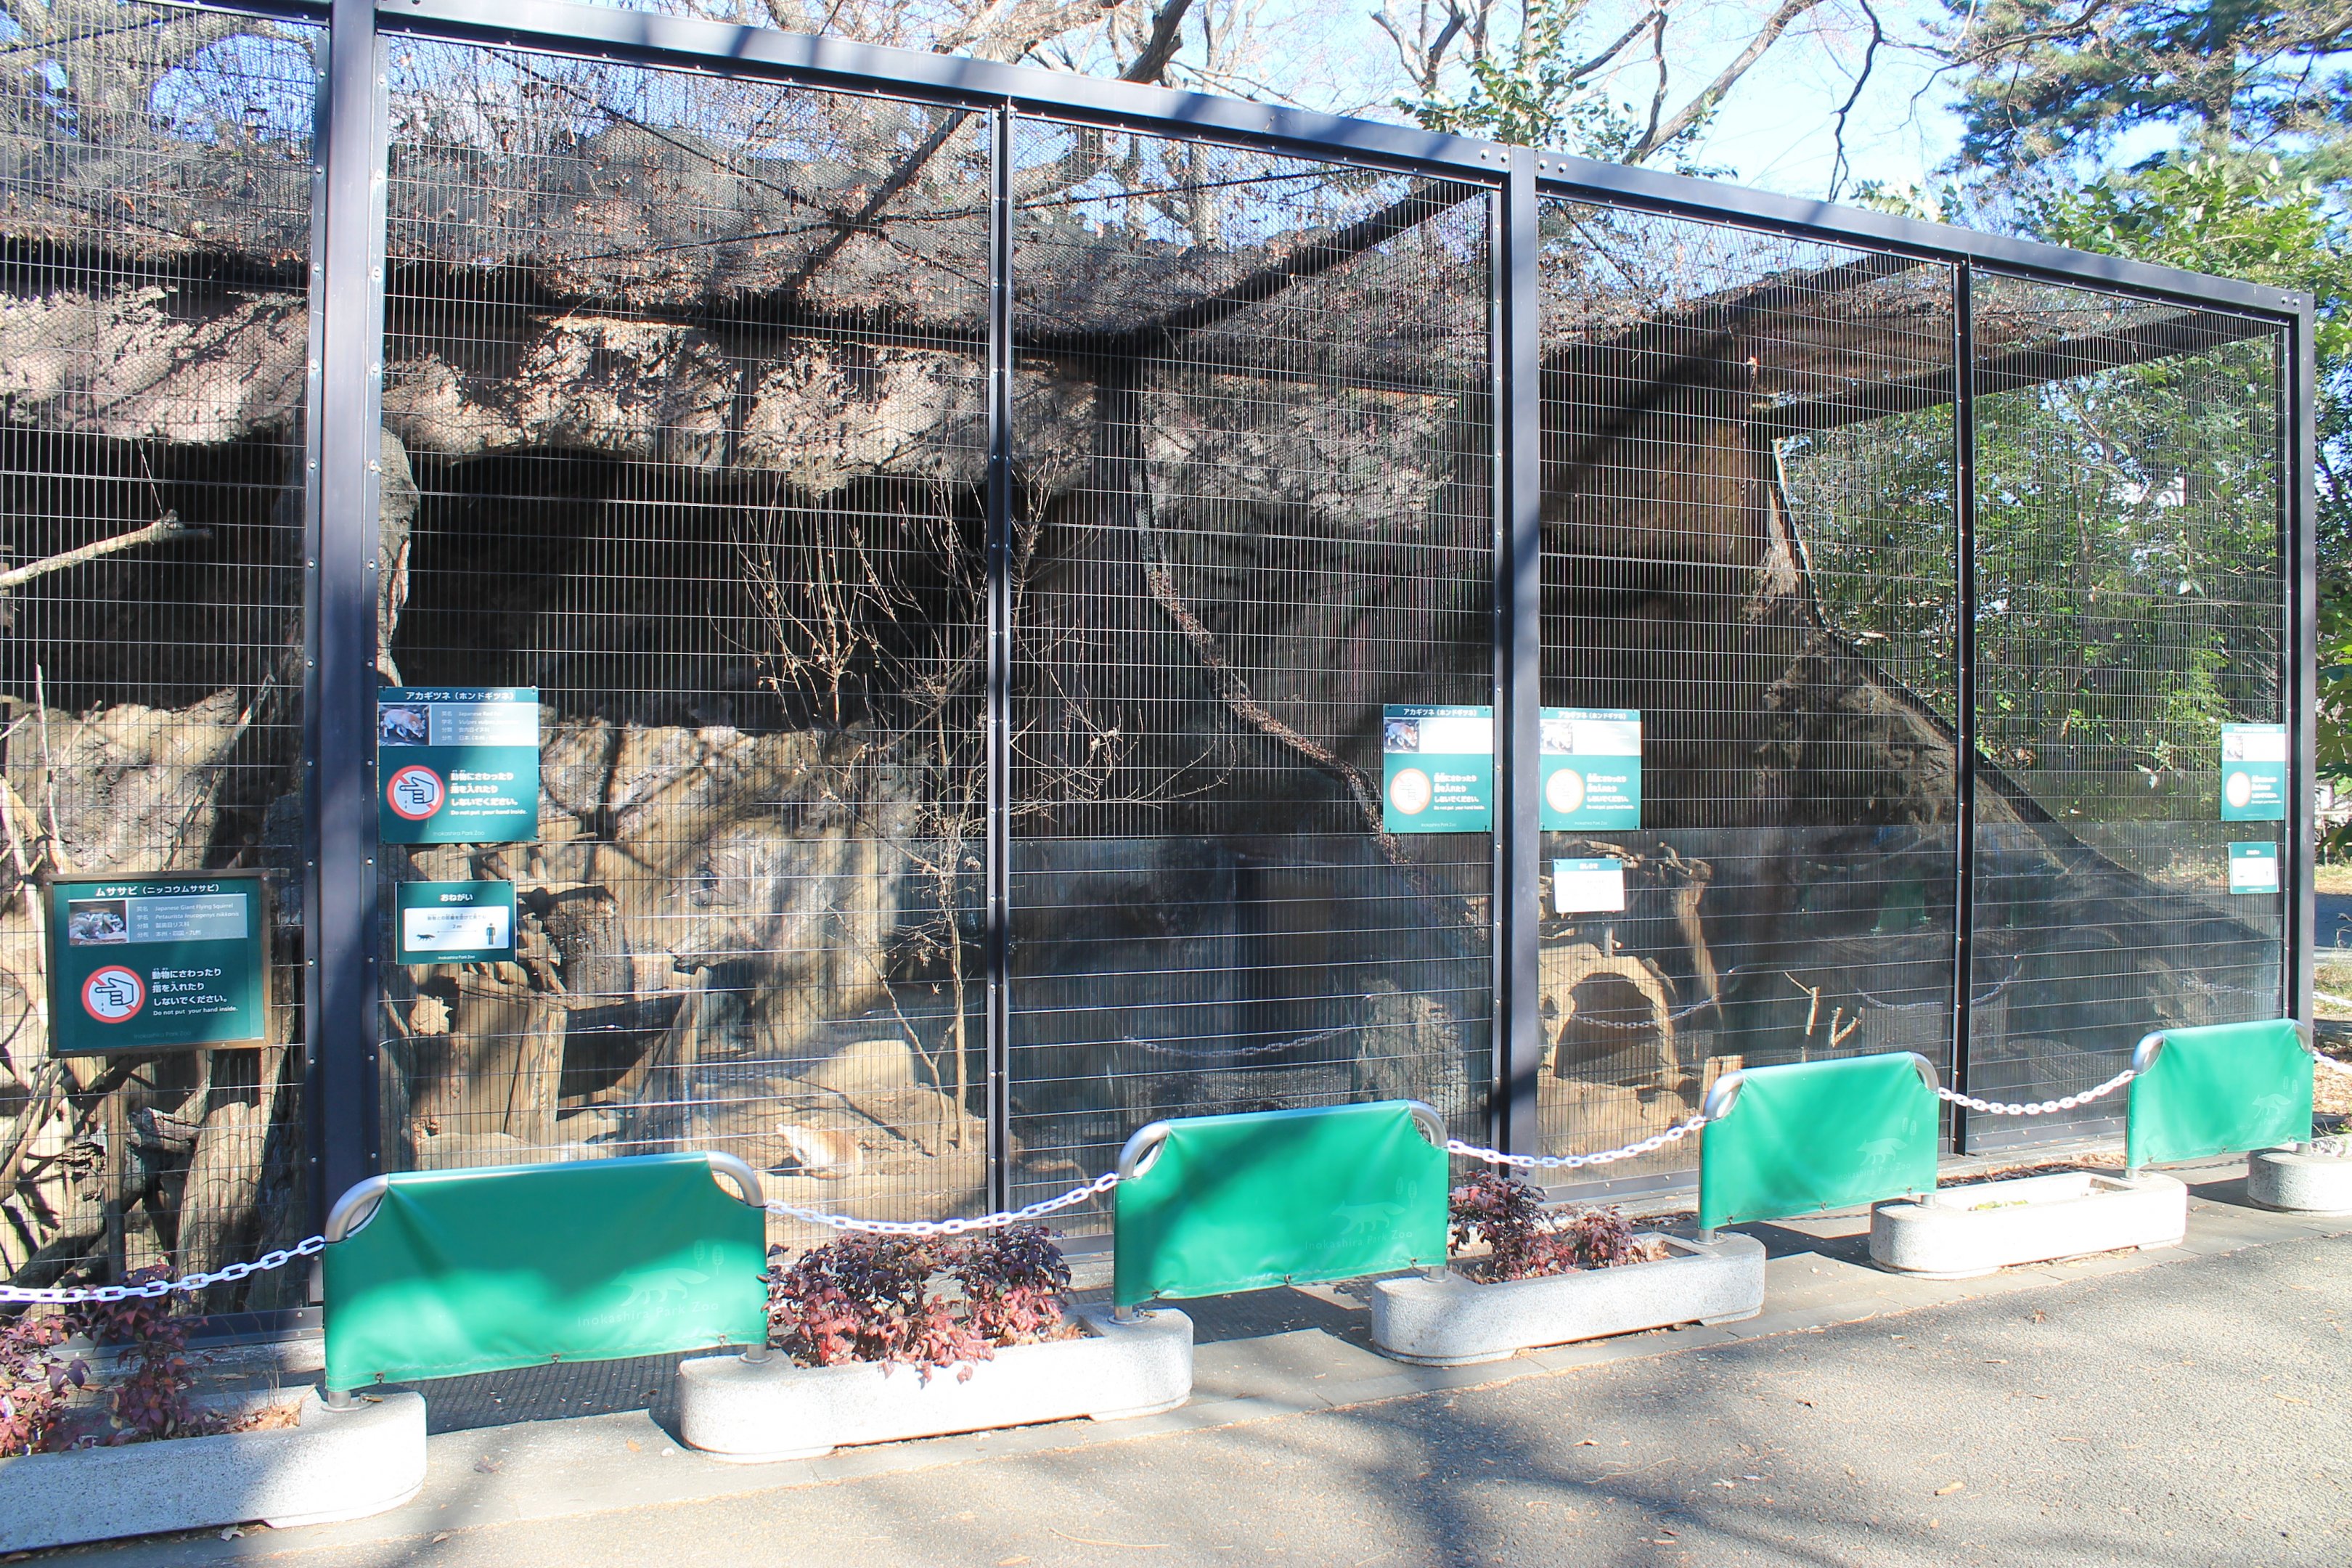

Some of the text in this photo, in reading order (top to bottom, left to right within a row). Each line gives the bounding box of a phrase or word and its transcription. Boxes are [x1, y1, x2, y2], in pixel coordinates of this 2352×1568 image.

[406, 691, 515, 701] アカギツネ（ホンドギツネ）
[95, 883, 220, 897] ムササビ（ニッコウムササビ）
[440, 893, 473, 902] おねがい
[152, 968, 221, 980] 動物にさわったり
[152, 982, 205, 993] 指を入れたり
[153, 995, 227, 1006] しないでください。
[1304, 1230, 1413, 1250] Inokashira Park Zoo
[577, 1301, 719, 1328] Inokashira Park Zoo
